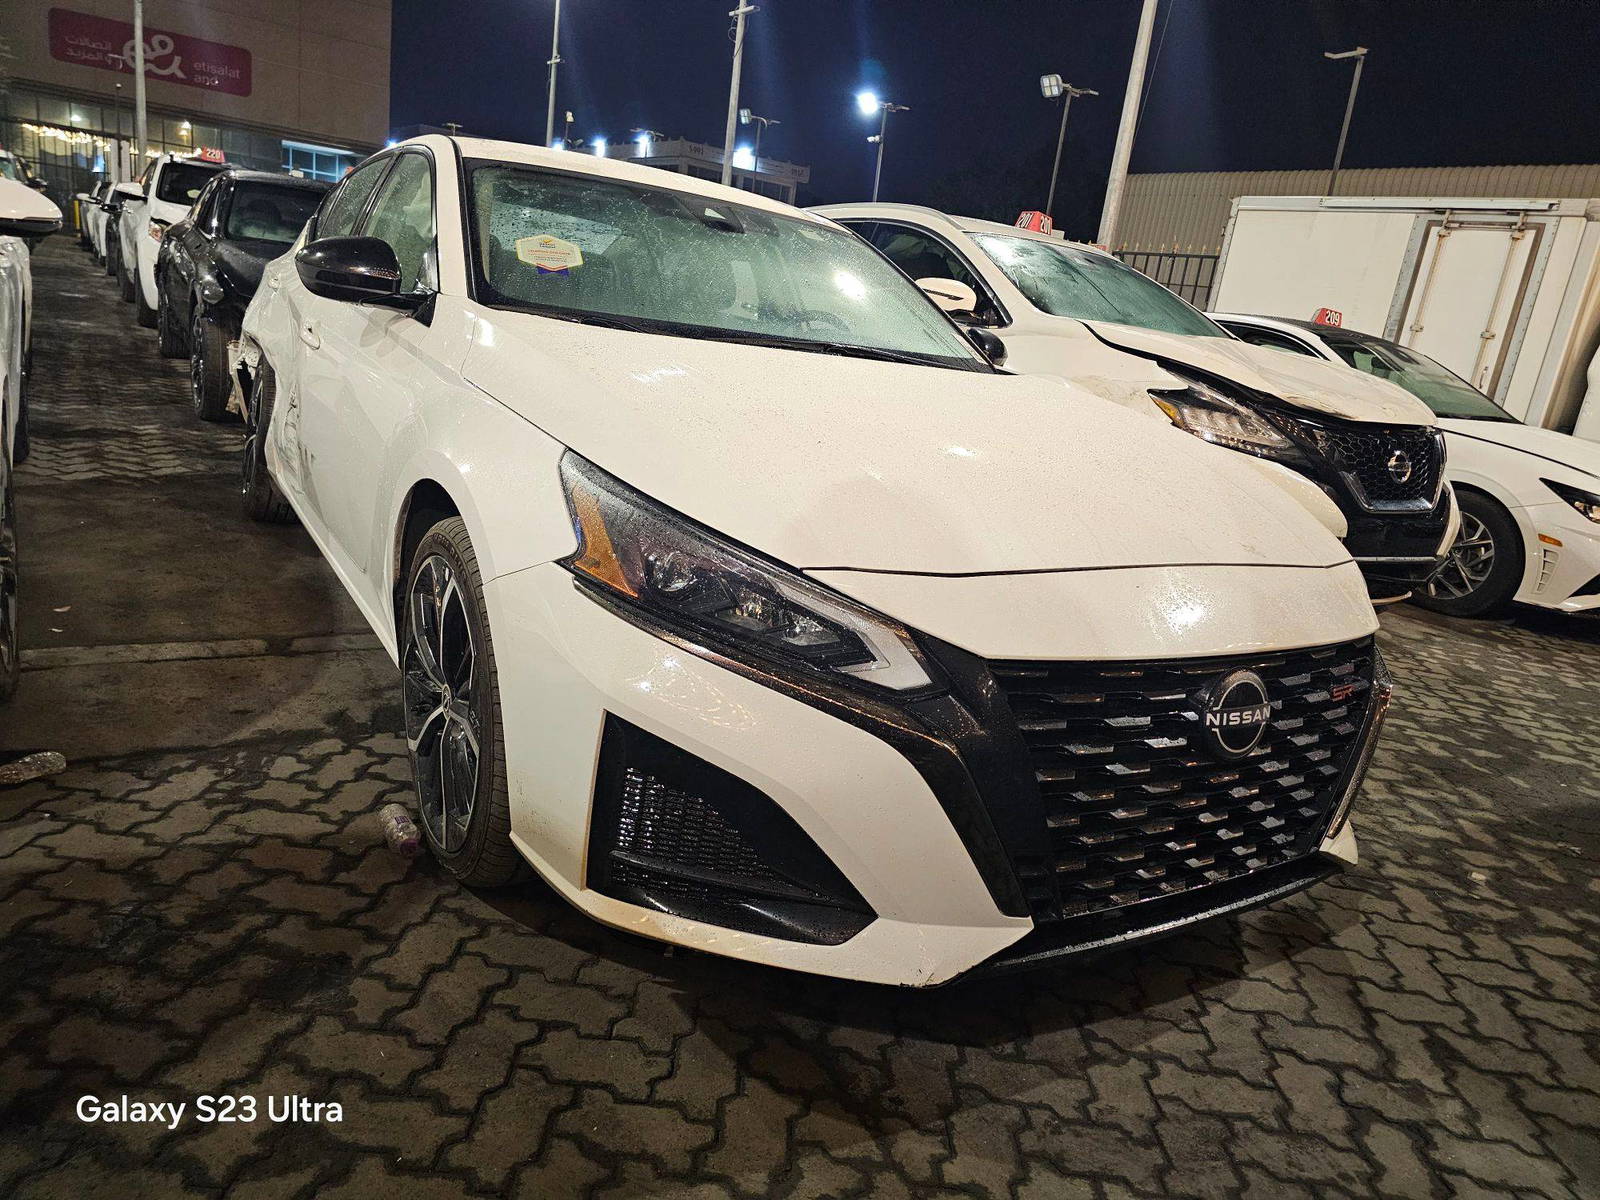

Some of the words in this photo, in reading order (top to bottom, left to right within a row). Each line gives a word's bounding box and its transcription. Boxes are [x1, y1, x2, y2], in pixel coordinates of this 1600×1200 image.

[193, 62, 241, 80] etisalat
[206, 148, 221, 159] 220
[1325, 310, 1339, 326] 209
[1206, 707, 1271, 726] NISSAN
